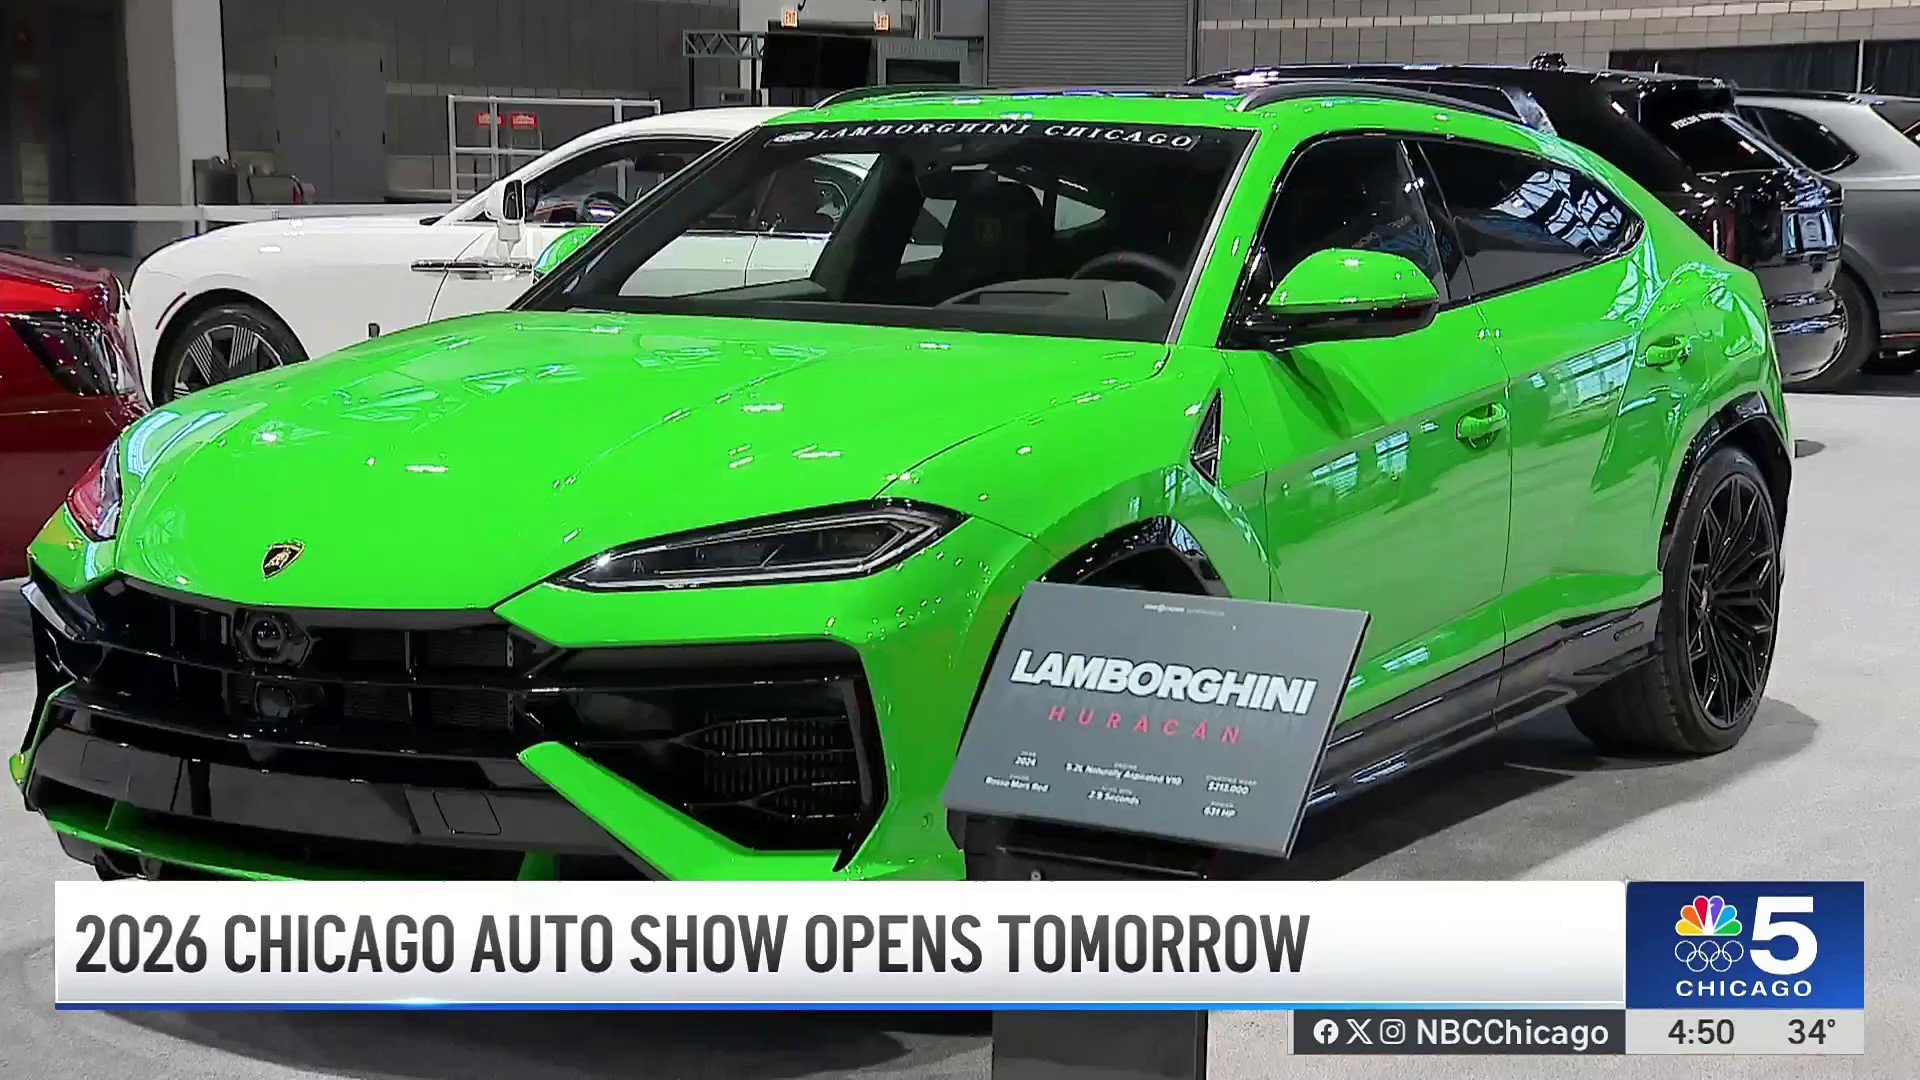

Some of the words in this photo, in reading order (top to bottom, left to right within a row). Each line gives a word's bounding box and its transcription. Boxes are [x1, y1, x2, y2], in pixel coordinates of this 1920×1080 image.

[813, 123, 1031, 141] LAMBORGHINI
[1044, 125, 1192, 147] CHICAGO
[1009, 650, 1318, 716] LAMBORGHINI
